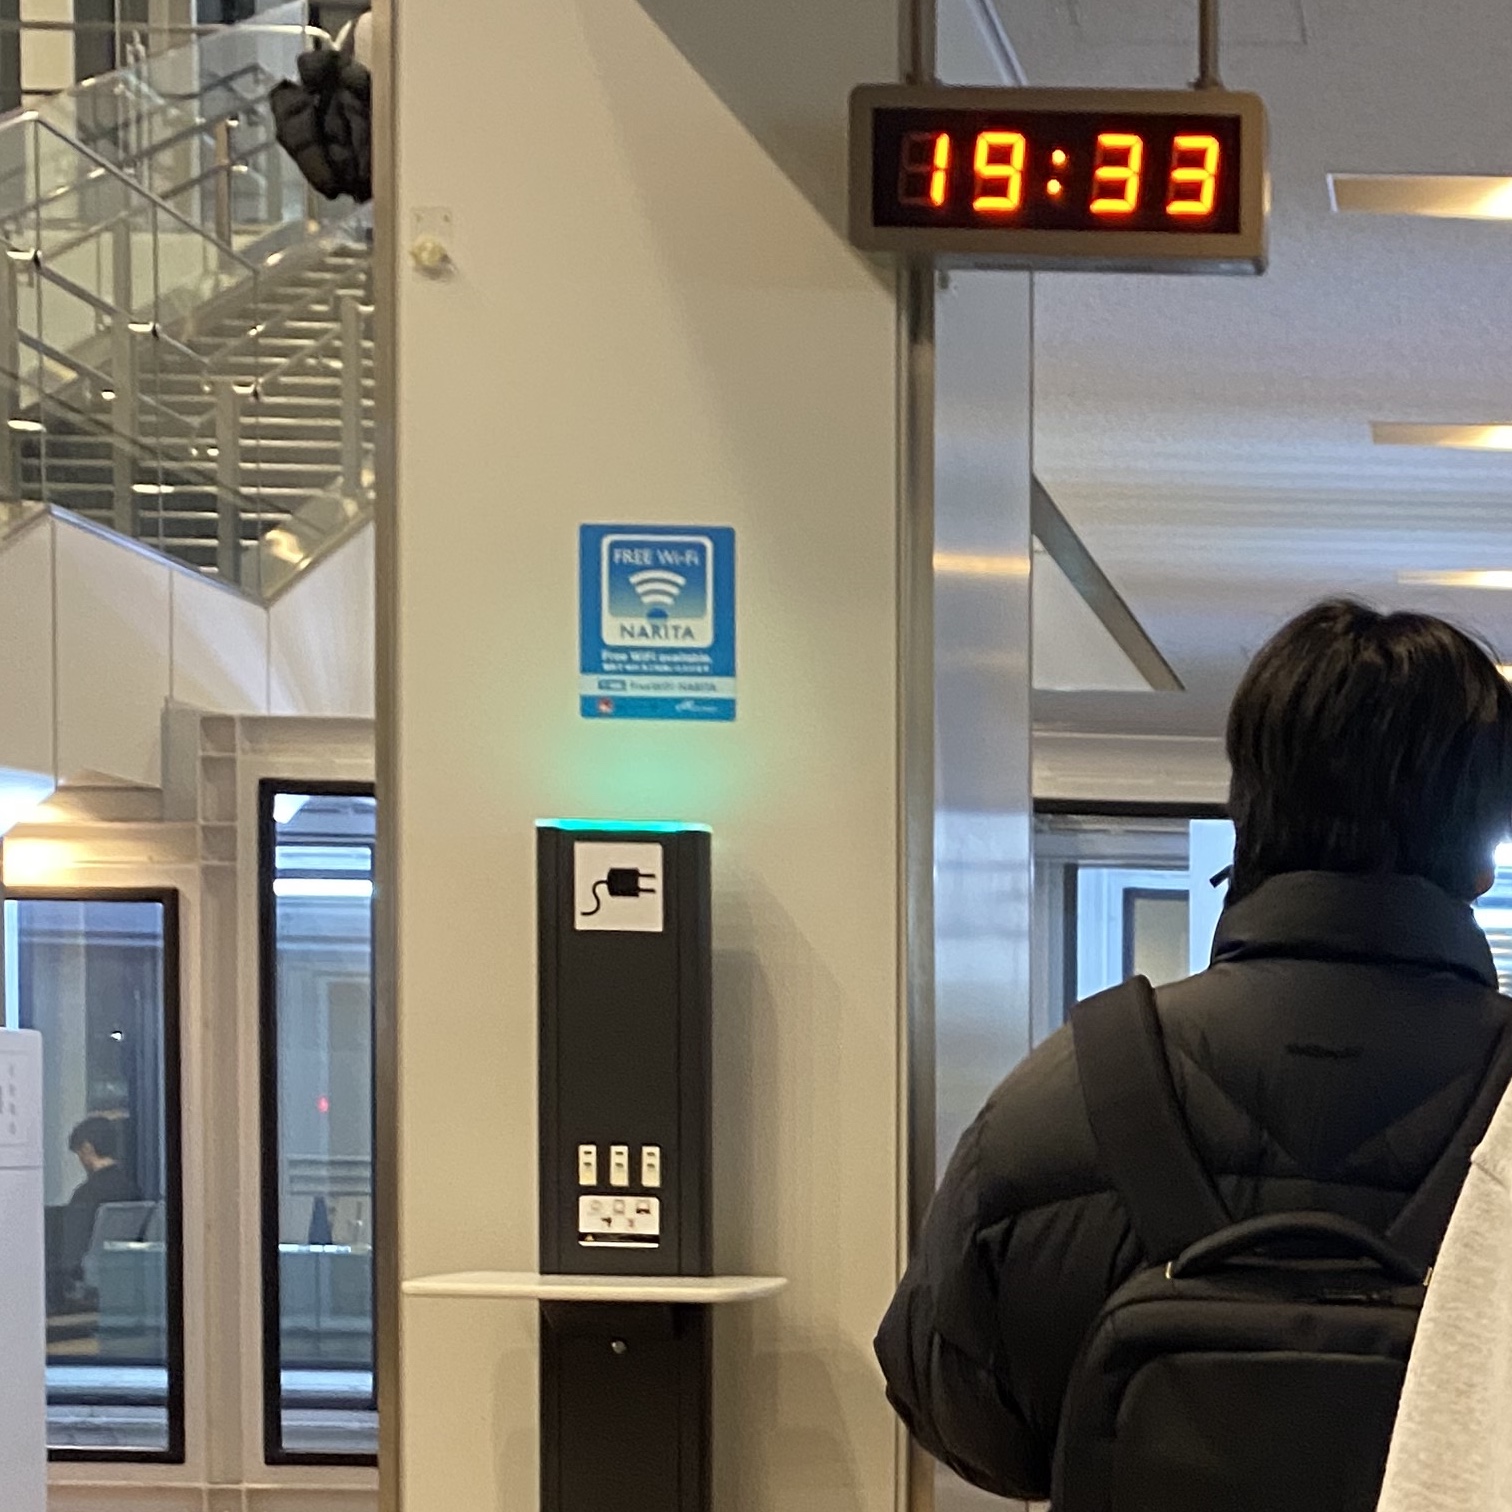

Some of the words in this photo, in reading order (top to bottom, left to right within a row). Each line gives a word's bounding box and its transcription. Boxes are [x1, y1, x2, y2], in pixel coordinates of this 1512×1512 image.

[930, 131, 1220, 215] 19:33
[613, 548, 652, 565] FREE
[656, 549, 699, 566] Wi-Fi
[620, 623, 695, 640] NARITA
